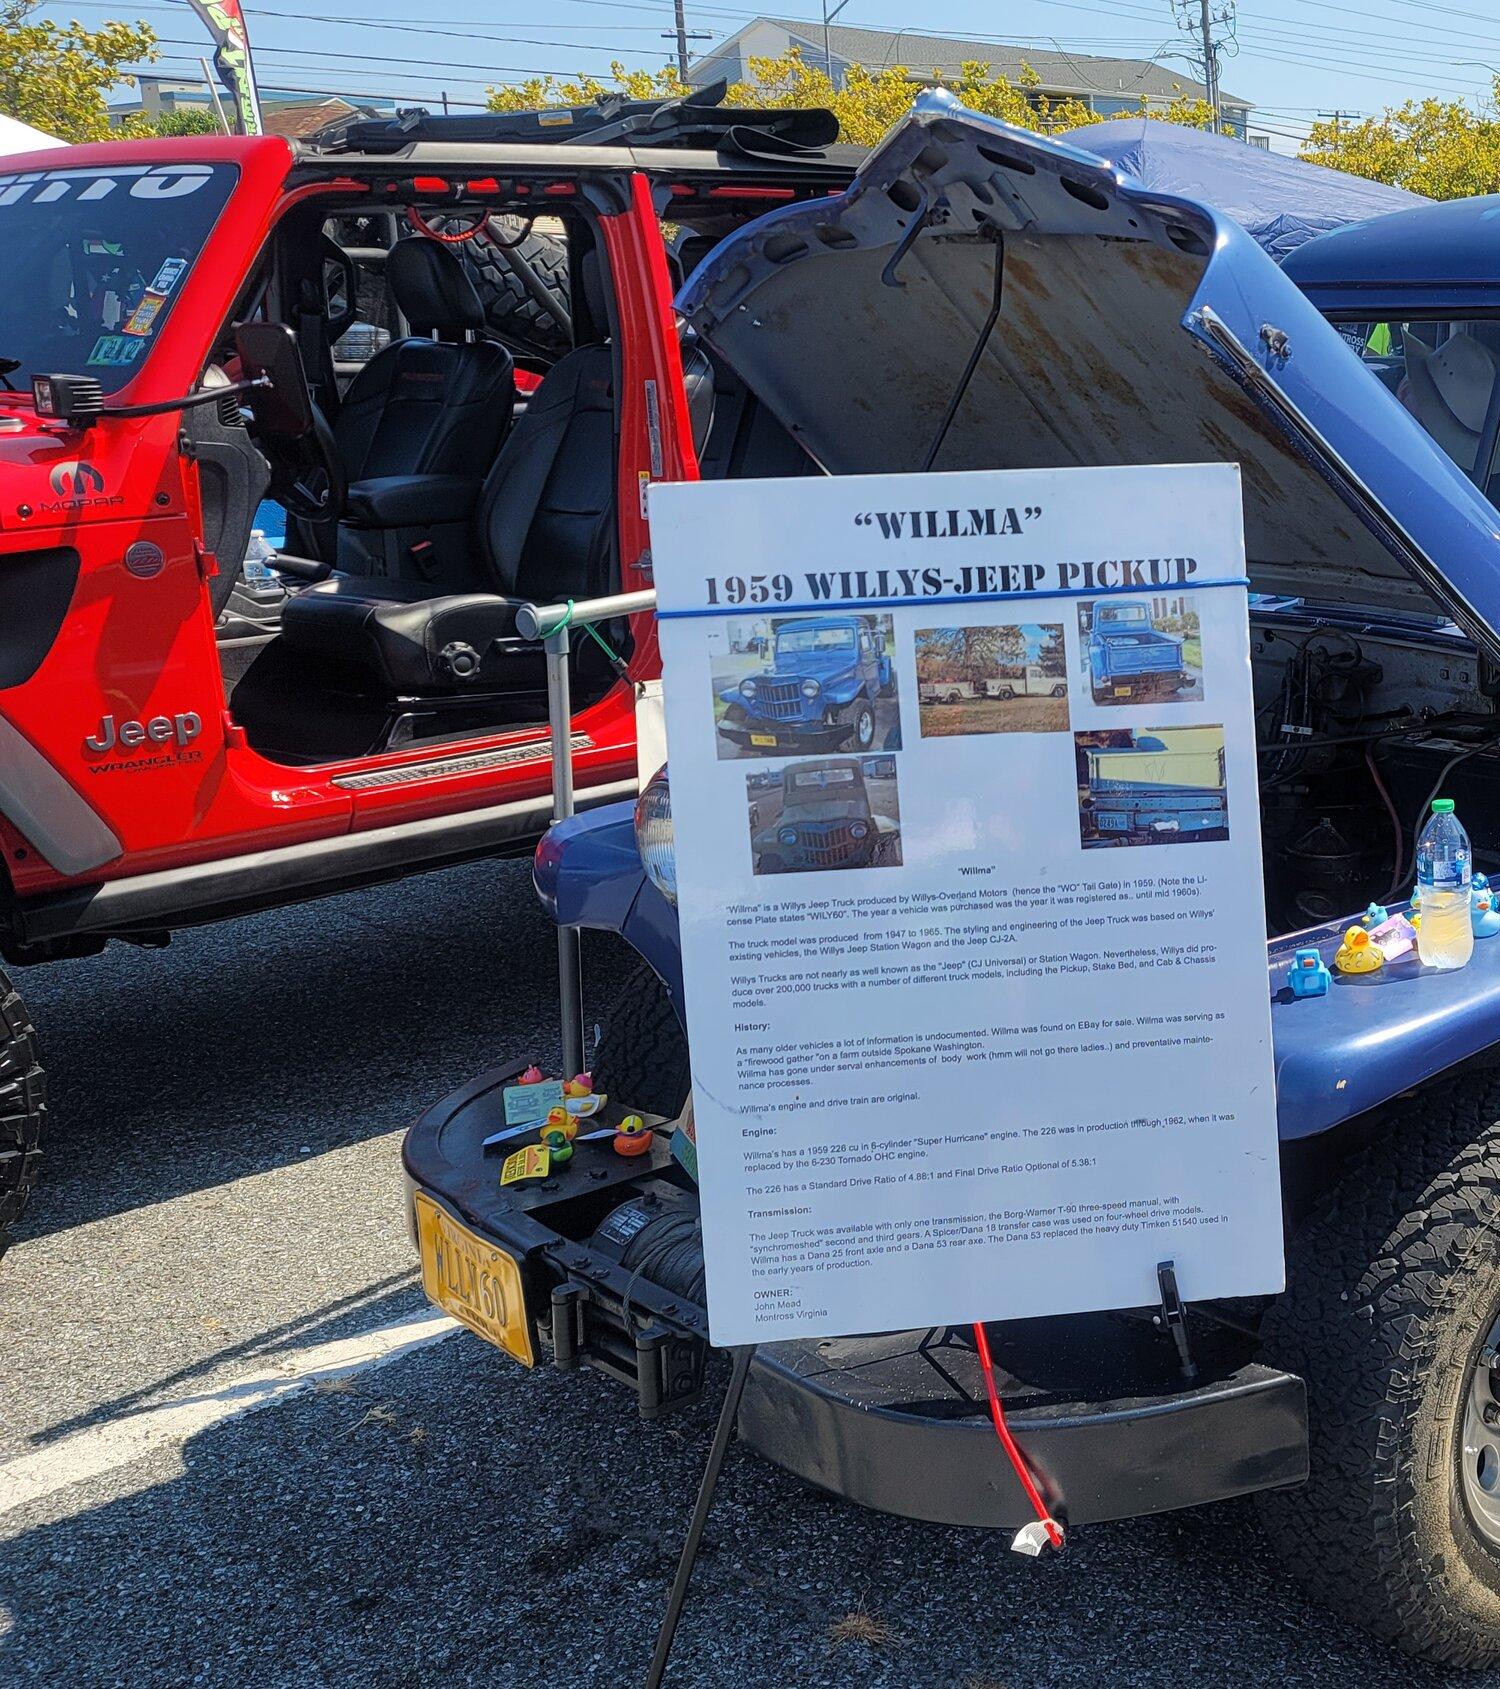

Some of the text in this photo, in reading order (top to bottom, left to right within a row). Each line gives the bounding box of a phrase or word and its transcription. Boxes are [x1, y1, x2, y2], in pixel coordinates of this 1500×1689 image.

[39, 495, 125, 513] MOPAR
[705, 557, 1198, 605] 1959 WILLYS-JEEP PICKUP
[86, 711, 202, 752] Jeep
[89, 750, 203, 774] WRANGLER
[762, 902, 772, 912] is
[772, 903, 779, 912] a
[779, 900, 807, 912] Willys
[807, 899, 831, 910] Jeep
[830, 897, 856, 908] Truck
[856, 894, 898, 908] produced
[897, 893, 910, 905] by
[910, 888, 978, 904] Willys-Overland
[978, 888, 1009, 899] Motors
[1011, 886, 1041, 898] (hence
[1041, 884, 1057, 895] the
[1080, 881, 1097, 892] Tail
[1122, 879, 1131, 890] in
[1156, 876, 1181, 888] (Note
[1180, 875, 1196, 885] the
[728, 951, 763, 962] existing
[802, 947, 818, 957] the
[818, 945, 846, 957] Willys
[846, 943, 868, 954] Jeep
[869, 941, 900, 953] Station
[900, 940, 932, 951] Wagon
[932, 937, 950, 948] and
[950, 936, 966, 947] the
[966, 935, 988, 947] Jeep
[730, 987, 754, 997] duce
[754, 986, 775, 996] over
[775, 982, 812, 995] 200,000
[812, 980, 840, 992] trucks
[839, 979, 859, 989] with
[859, 980, 867, 988] a
[867, 976, 902, 988] number
[901, 974, 912, 985] of
[911, 973, 948, 984] different
[948, 971, 970, 982] truck
[1005, 966, 1043, 978] including
[1043, 965, 1059, 975] the
[1091, 961, 1117, 972] Stake
[1137, 958, 1155, 969] and
[1155, 957, 1174, 967] Cab
[1182, 954, 1217, 965] Chassis
[735, 1059, 743, 1068] a
[785, 1053, 815, 1066] gather
[831, 1052, 839, 1061] a
[838, 1049, 860, 1060] farm
[860, 1046, 893, 1058] outside
[893, 1044, 932, 1057] Spokane
[736, 1068, 767, 1079] Willma
[767, 1067, 786, 1077] has
[785, 1066, 809, 1077] gone
[809, 1063, 836, 1074] under
[863, 1056, 927, 1070] enhancements
[927, 1054, 938, 1065] of
[940, 1053, 963, 1064] body
[965, 1051, 987, 1062] work
[987, 1050, 1013, 1062] (hmm
[1012, 1047, 1028, 1058] will
[1029, 1046, 1044, 1056] not
[1043, 1047, 1056, 1057] go
[1056, 1045, 1079, 1055] there
[1113, 1039, 1131, 1050] and
[1131, 1036, 1182, 1051] preventative
[737, 1081, 765, 1091] nance
[743, 1160, 782, 1174] replaced
[782, 1159, 795, 1171] by
[794, 1159, 810, 1168] the
[810, 1155, 837, 1167] 6-230
[836, 1152, 873, 1165] Tornado
[873, 1150, 896, 1162] OHC
[744, 1156, 1097, 1196] The 226 has a Standard Drive Ratio of 4.88:1 and Final Drive Ratio Optional of 5.38:1
[747, 1232, 767, 1242] The
[767, 1231, 790, 1241] Jeep
[789, 1227, 815, 1238] Truck
[815, 1227, 835, 1236] was
[835, 1222, 874, 1235] available
[873, 1220, 893, 1231] with
[893, 1219, 913, 1230] only
[912, 1218, 930, 1228] one
[987, 1211, 1003, 1221] the
[1003, 1207, 1056, 1220] Borg-Warner
[1056, 1203, 1077, 1214] T-90
[1077, 1199, 1128, 1213] three-speed
[1162, 1195, 1180, 1205] with
[750, 1258, 873, 1277] the early years of production.
[753, 1298, 802, 1312] John Mead
[754, 1307, 828, 1323] Montross Virginia
